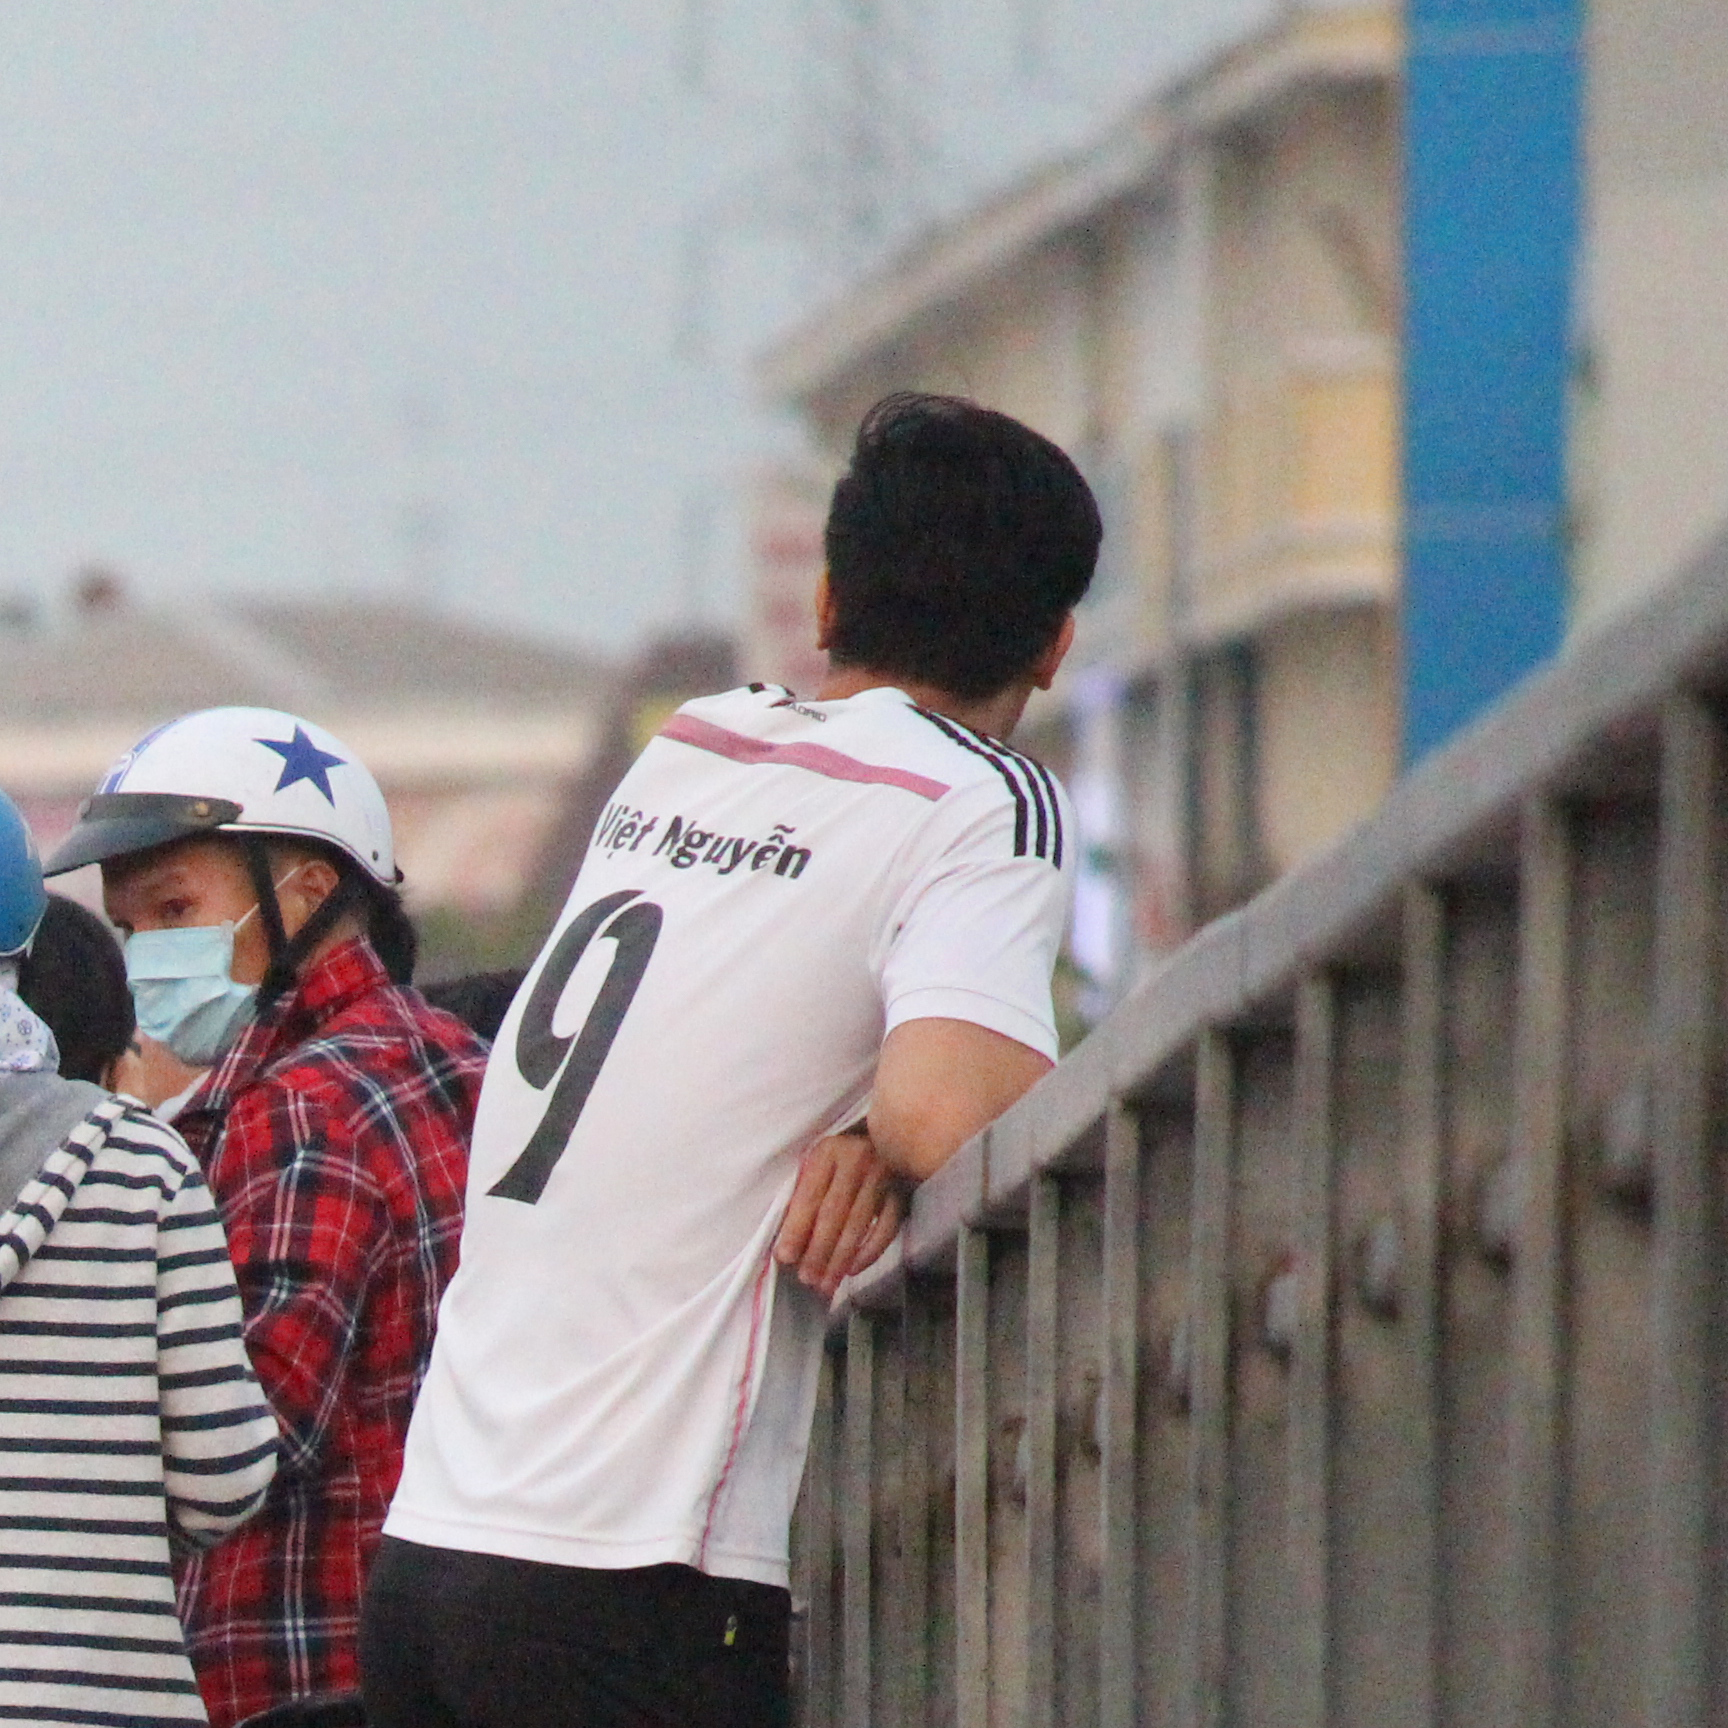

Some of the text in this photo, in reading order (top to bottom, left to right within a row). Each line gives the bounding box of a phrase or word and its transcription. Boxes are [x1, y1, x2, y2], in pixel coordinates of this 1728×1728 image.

[595, 802, 813, 879] Việt Nguyễn
[485, 889, 664, 1206] 9
